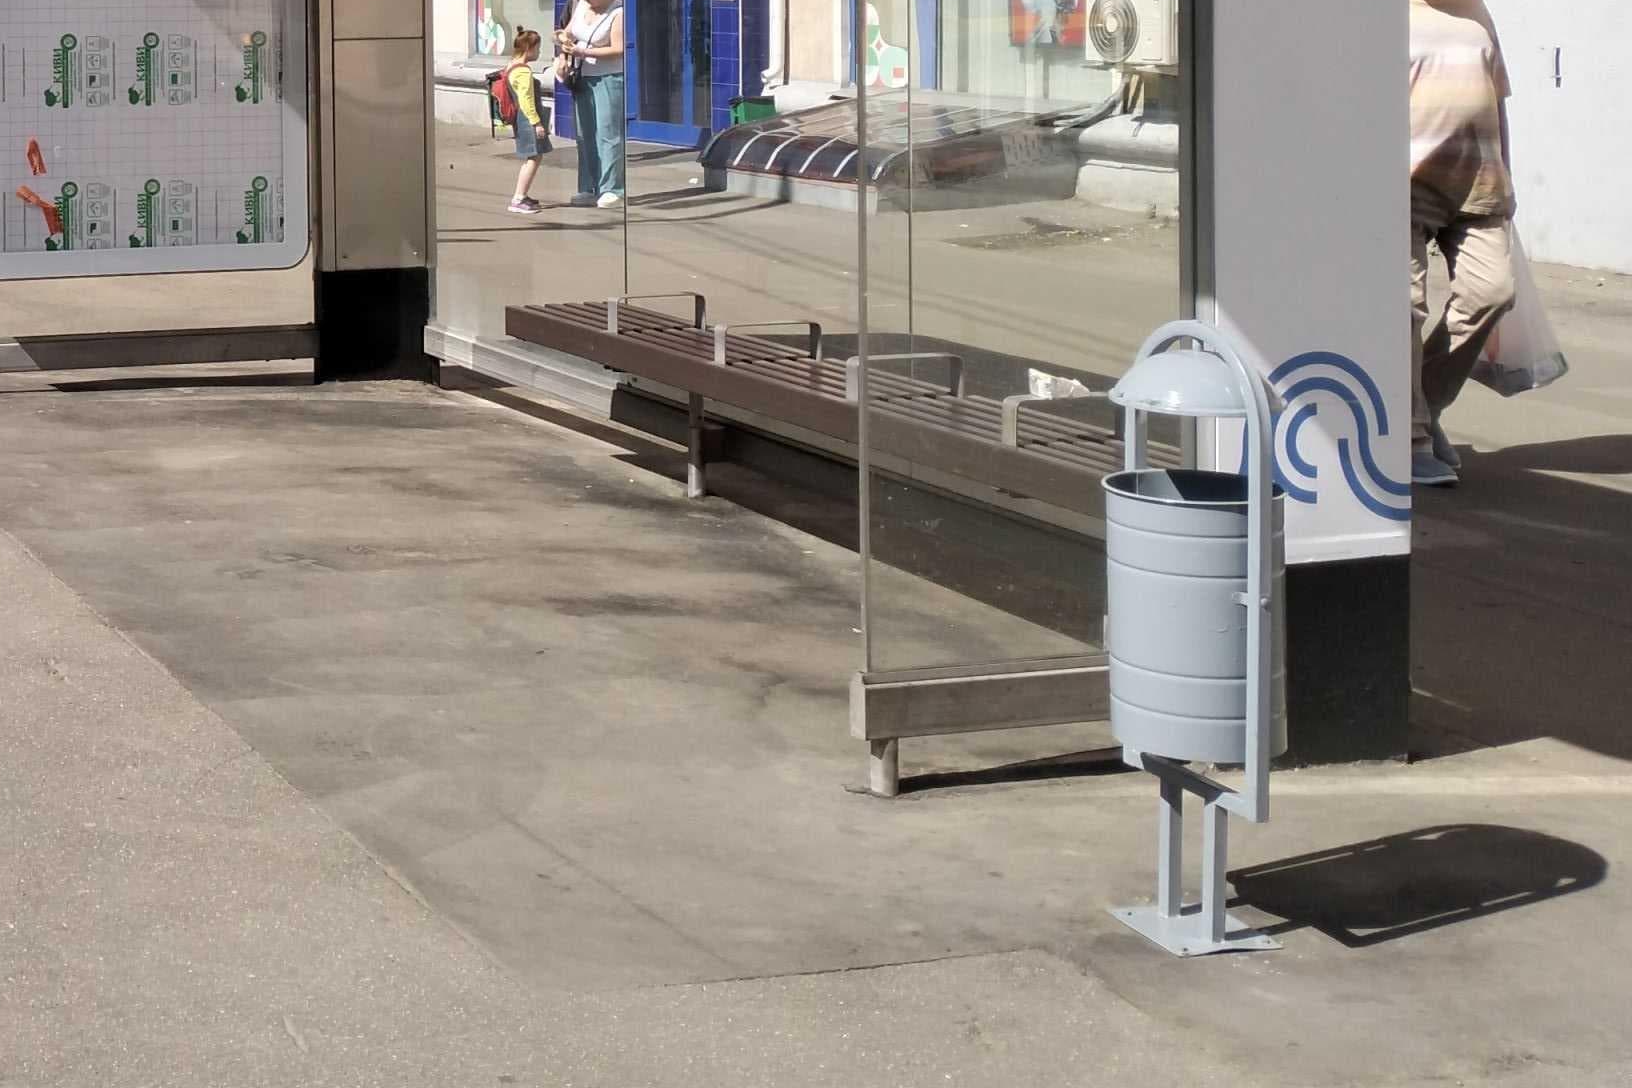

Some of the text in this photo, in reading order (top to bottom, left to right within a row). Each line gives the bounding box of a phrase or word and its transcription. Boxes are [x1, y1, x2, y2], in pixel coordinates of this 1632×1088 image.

[53, 48, 63, 83] КИВИ
[136, 46, 146, 81] КИВИ
[243, 45, 253, 80] КИВИ
[137, 193, 147, 228] КИВИ
[244, 190, 254, 225] КИВИ
